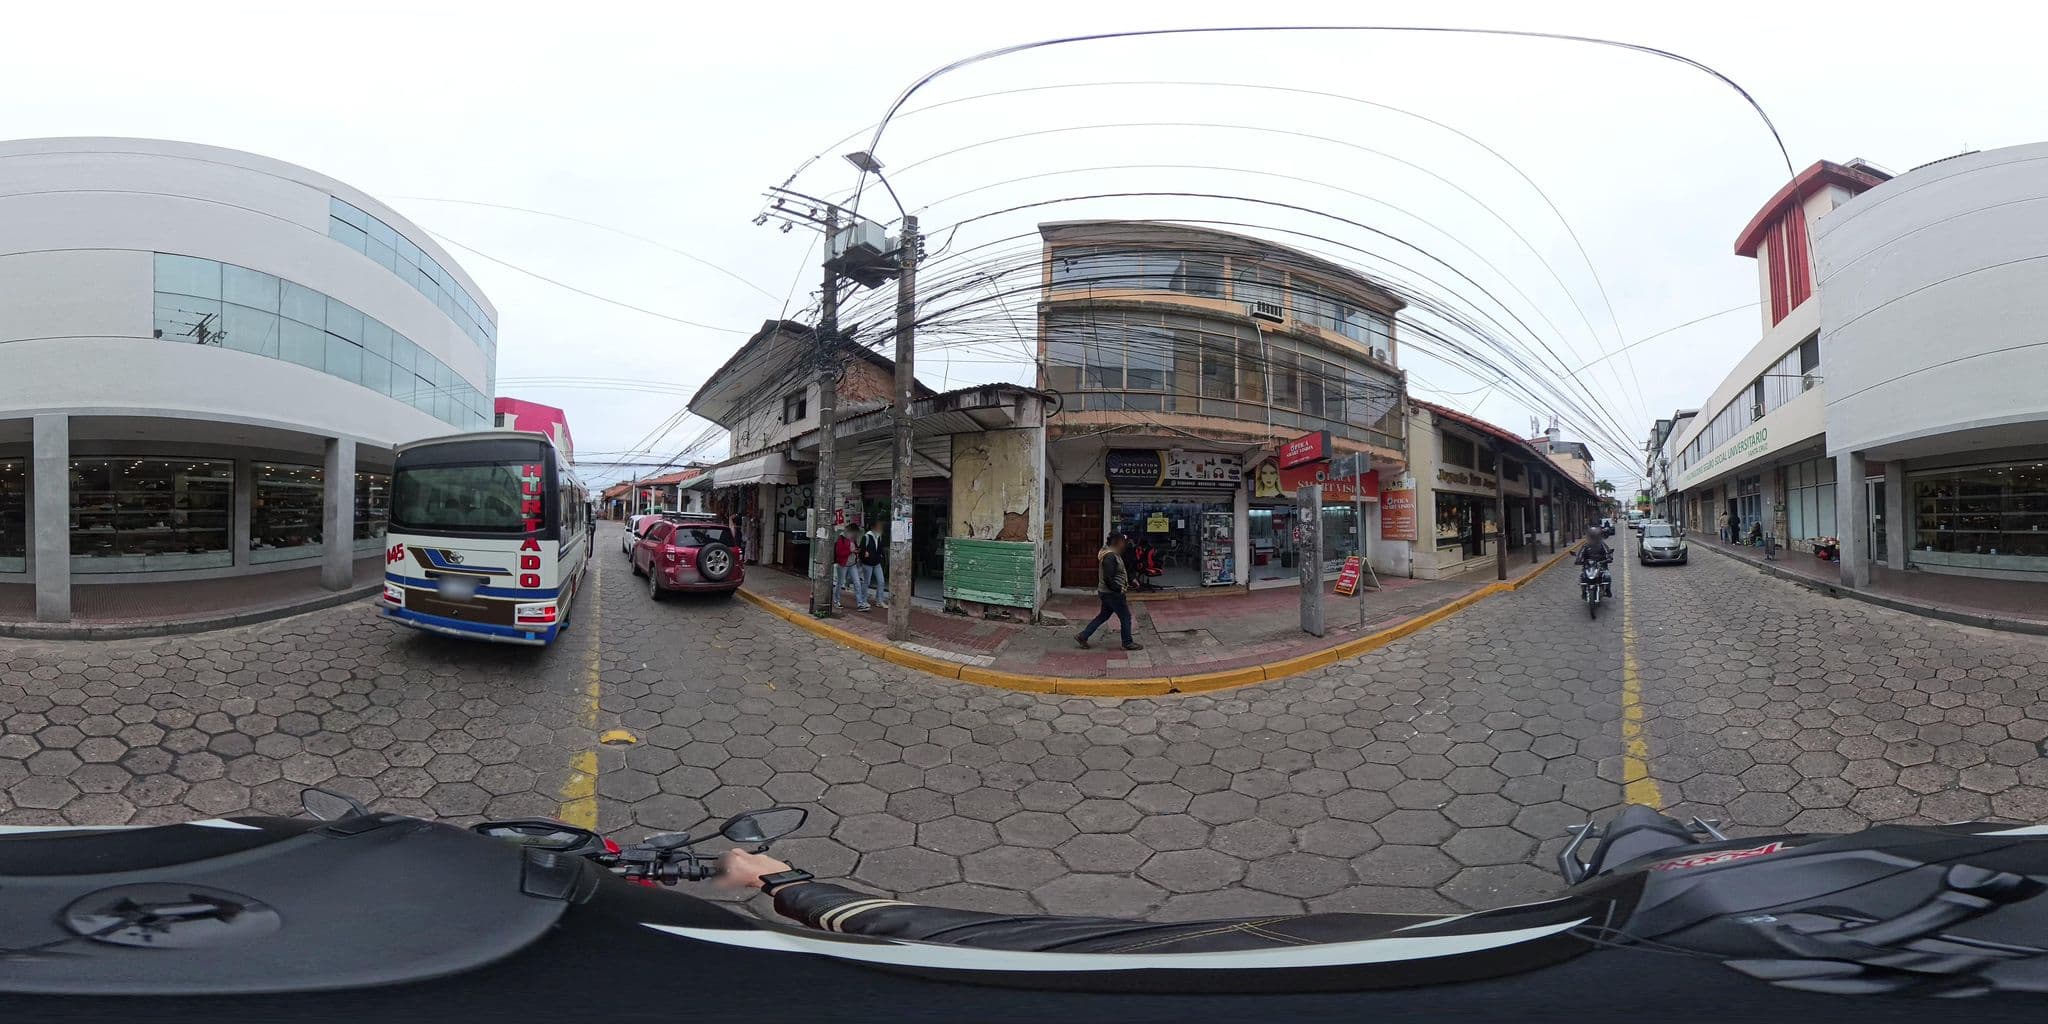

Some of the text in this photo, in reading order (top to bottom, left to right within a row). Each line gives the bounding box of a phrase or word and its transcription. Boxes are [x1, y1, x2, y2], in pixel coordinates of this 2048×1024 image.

[1728, 427, 1768, 459] UNIVERSITARIO
[1335, 482, 1367, 494] VISIN
[520, 464, 543, 588] HURTADO
